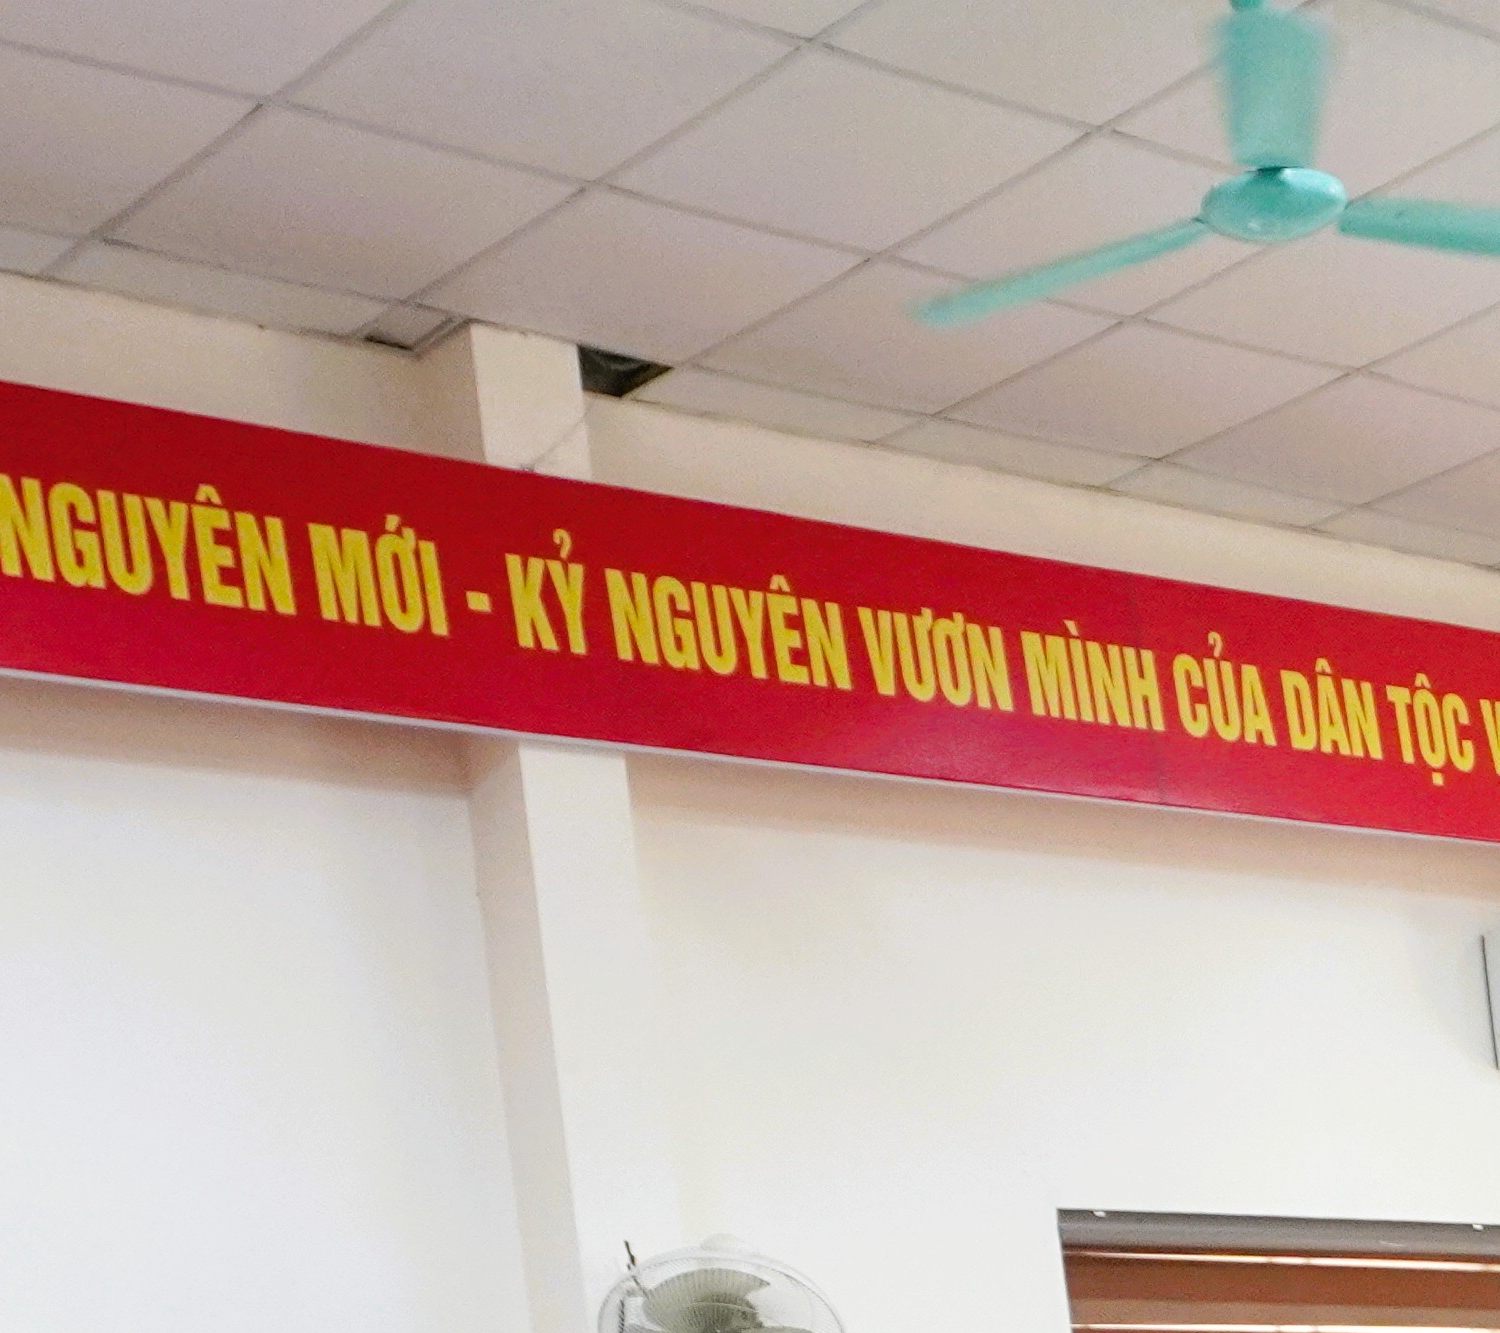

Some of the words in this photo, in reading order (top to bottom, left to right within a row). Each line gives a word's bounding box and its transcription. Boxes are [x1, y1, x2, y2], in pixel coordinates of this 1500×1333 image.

[309, 512, 449, 636] MỚI
[505, 528, 587, 655] KỶ
[606, 573, 852, 690] NGUYÊN
[858, 606, 1014, 711] VƯƠN
[1021, 616, 1166, 732] MÌNH
[1172, 630, 1277, 746] CỦA
[1280, 657, 1384, 760] DÂN
[1386, 681, 1476, 788] TỘC
